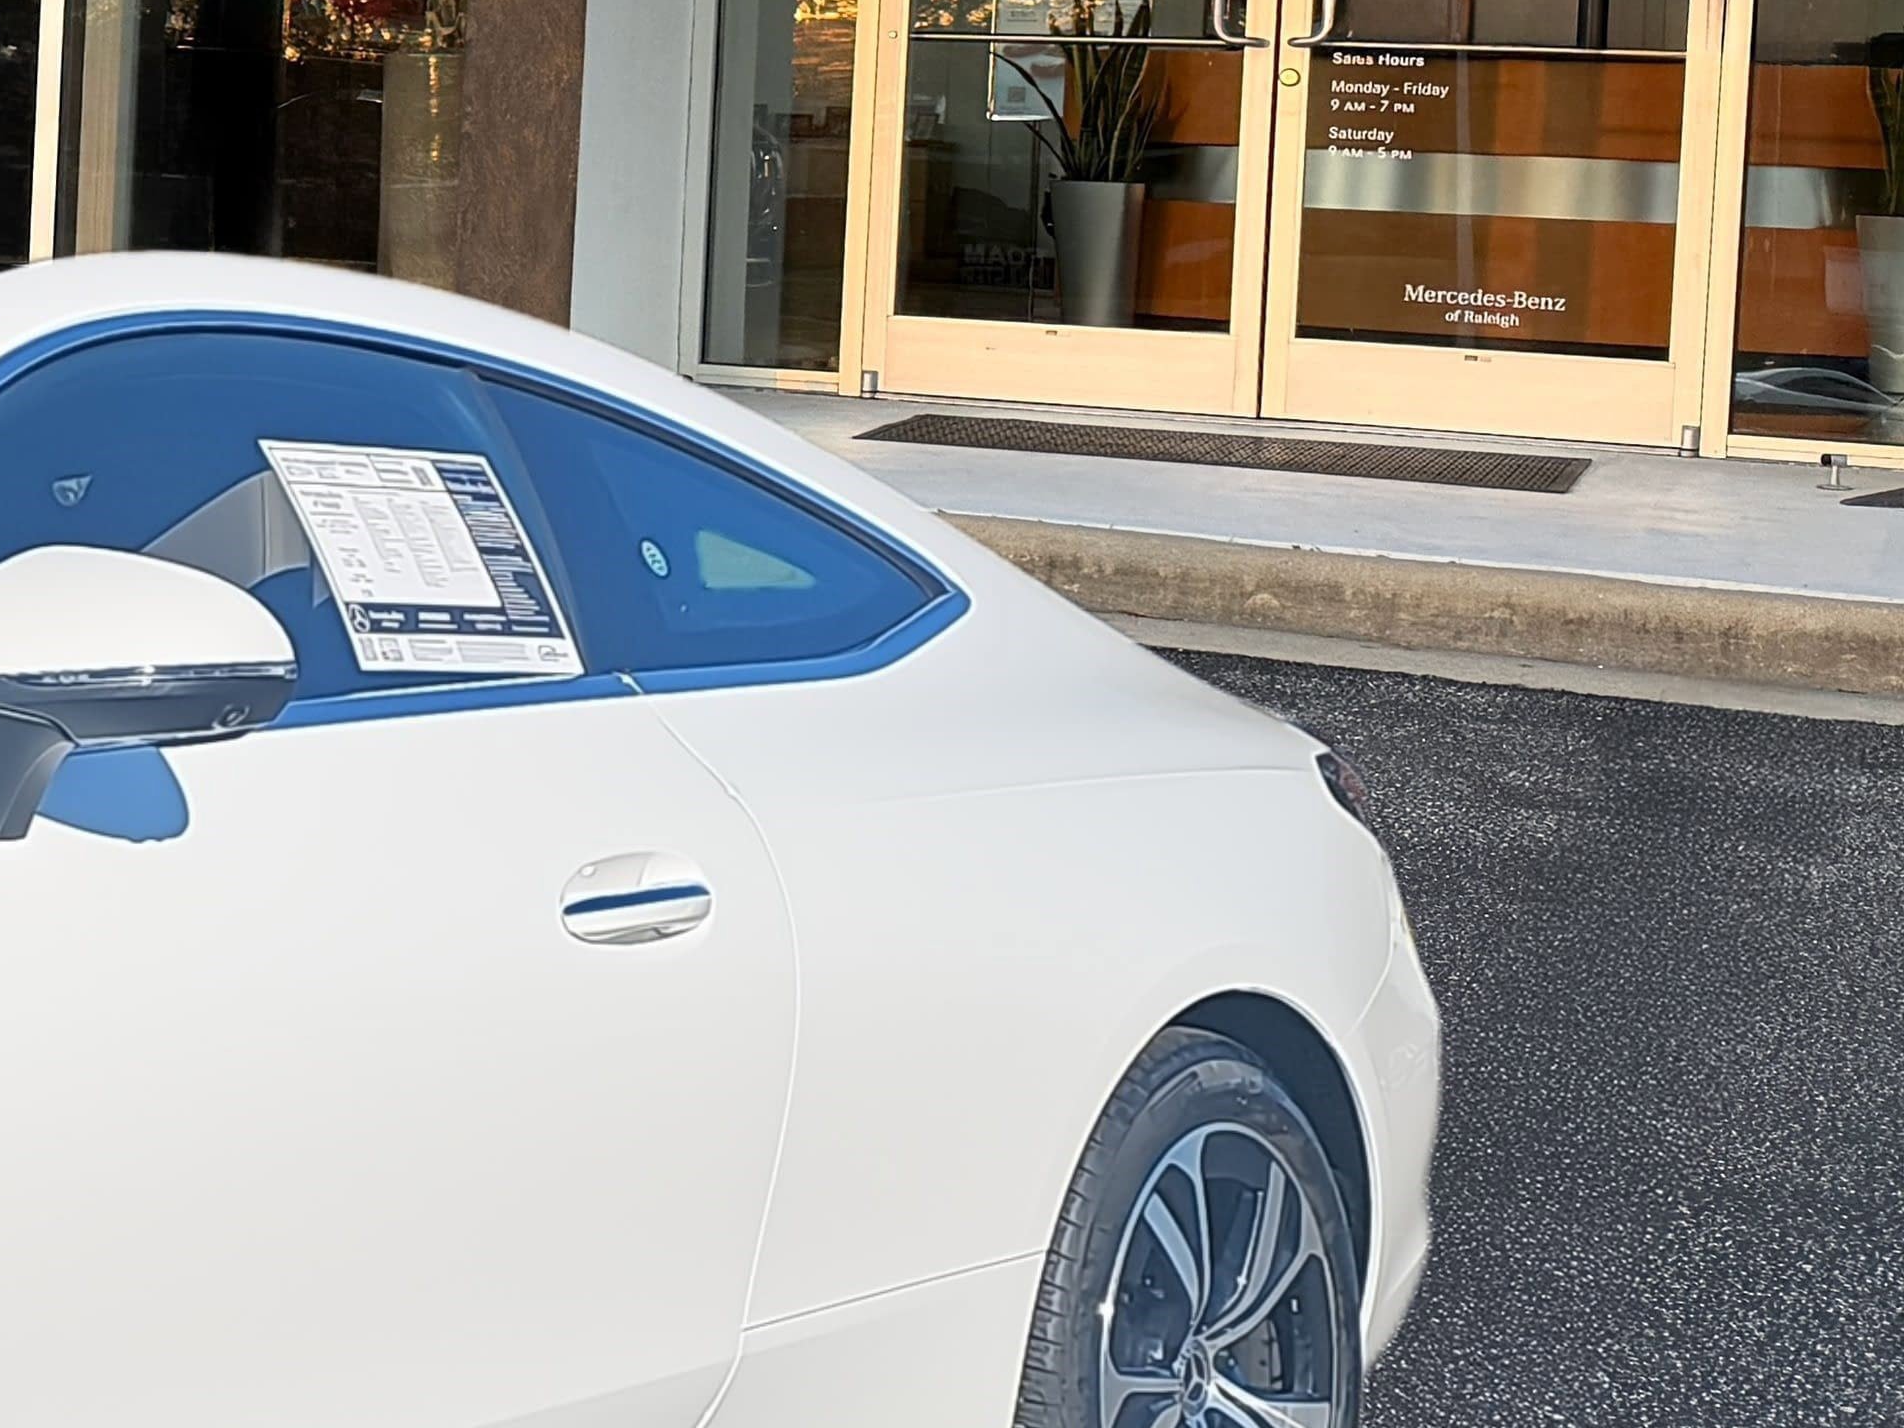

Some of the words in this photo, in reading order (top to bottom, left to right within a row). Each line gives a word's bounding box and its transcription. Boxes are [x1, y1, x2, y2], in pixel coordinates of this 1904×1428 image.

[1378, 53, 1425, 67] Hours
[1331, 80, 1390, 97] Monday
[1403, 82, 1450, 98] Friday
[1330, 98, 1340, 111] 9
[1343, 101, 1366, 112] AM
[1379, 100, 1389, 112] 7
[1393, 103, 1415, 113] PM
[1328, 126, 1394, 144] Saturday
[1342, 148, 1364, 158] AM
[1377, 147, 1386, 159] 5
[1391, 150, 1412, 160] PM
[1403, 284, 1566, 312] Mercedes-Benz
[1445, 310, 1462, 322] of
